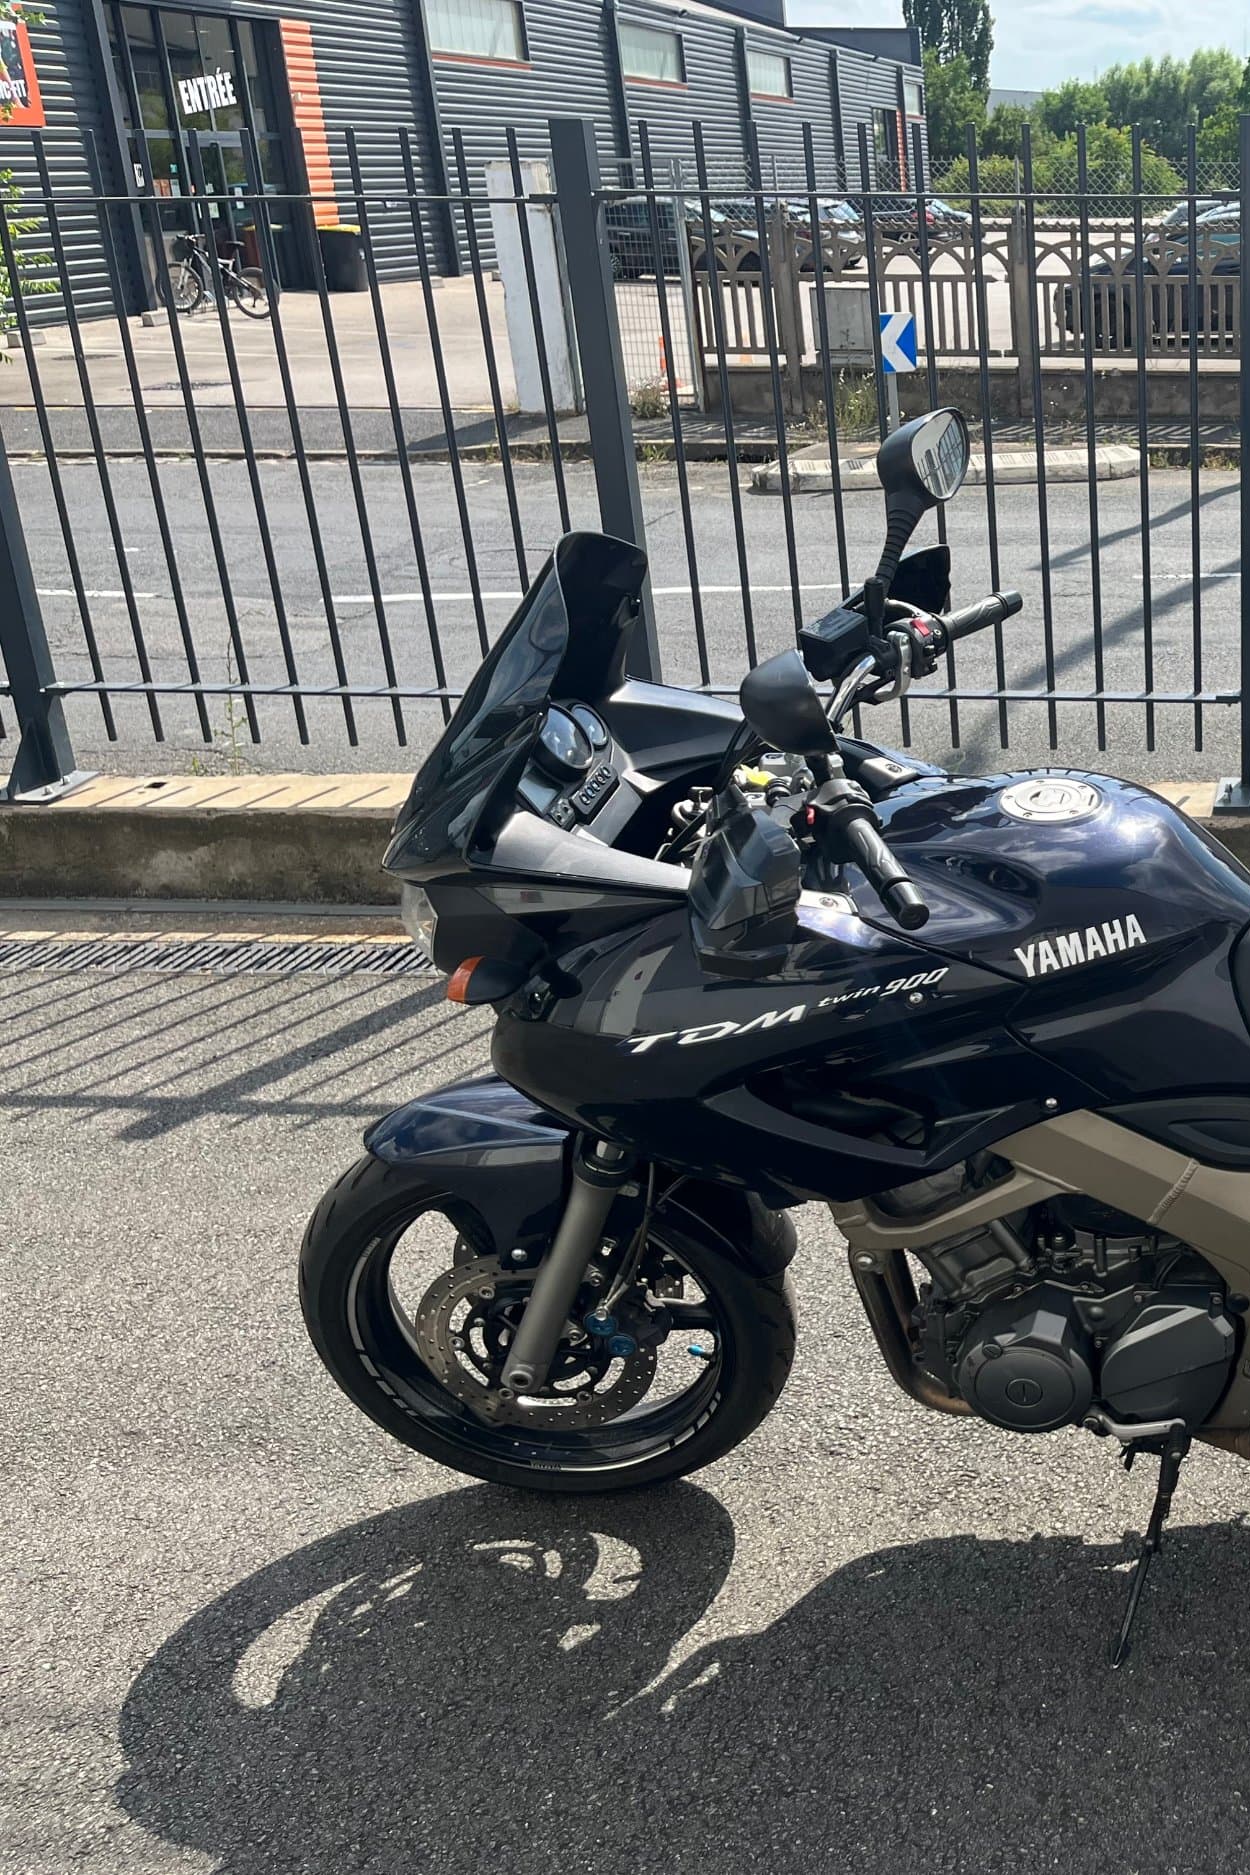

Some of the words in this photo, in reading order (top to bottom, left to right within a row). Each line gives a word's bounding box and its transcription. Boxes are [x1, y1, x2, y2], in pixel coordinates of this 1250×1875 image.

[178, 66, 238, 115] ENTRÉE
[1014, 913, 1147, 978] YAMAHA
[627, 1004, 807, 1054] TDM
[818, 985, 881, 1007] twin
[880, 967, 949, 997] 900
